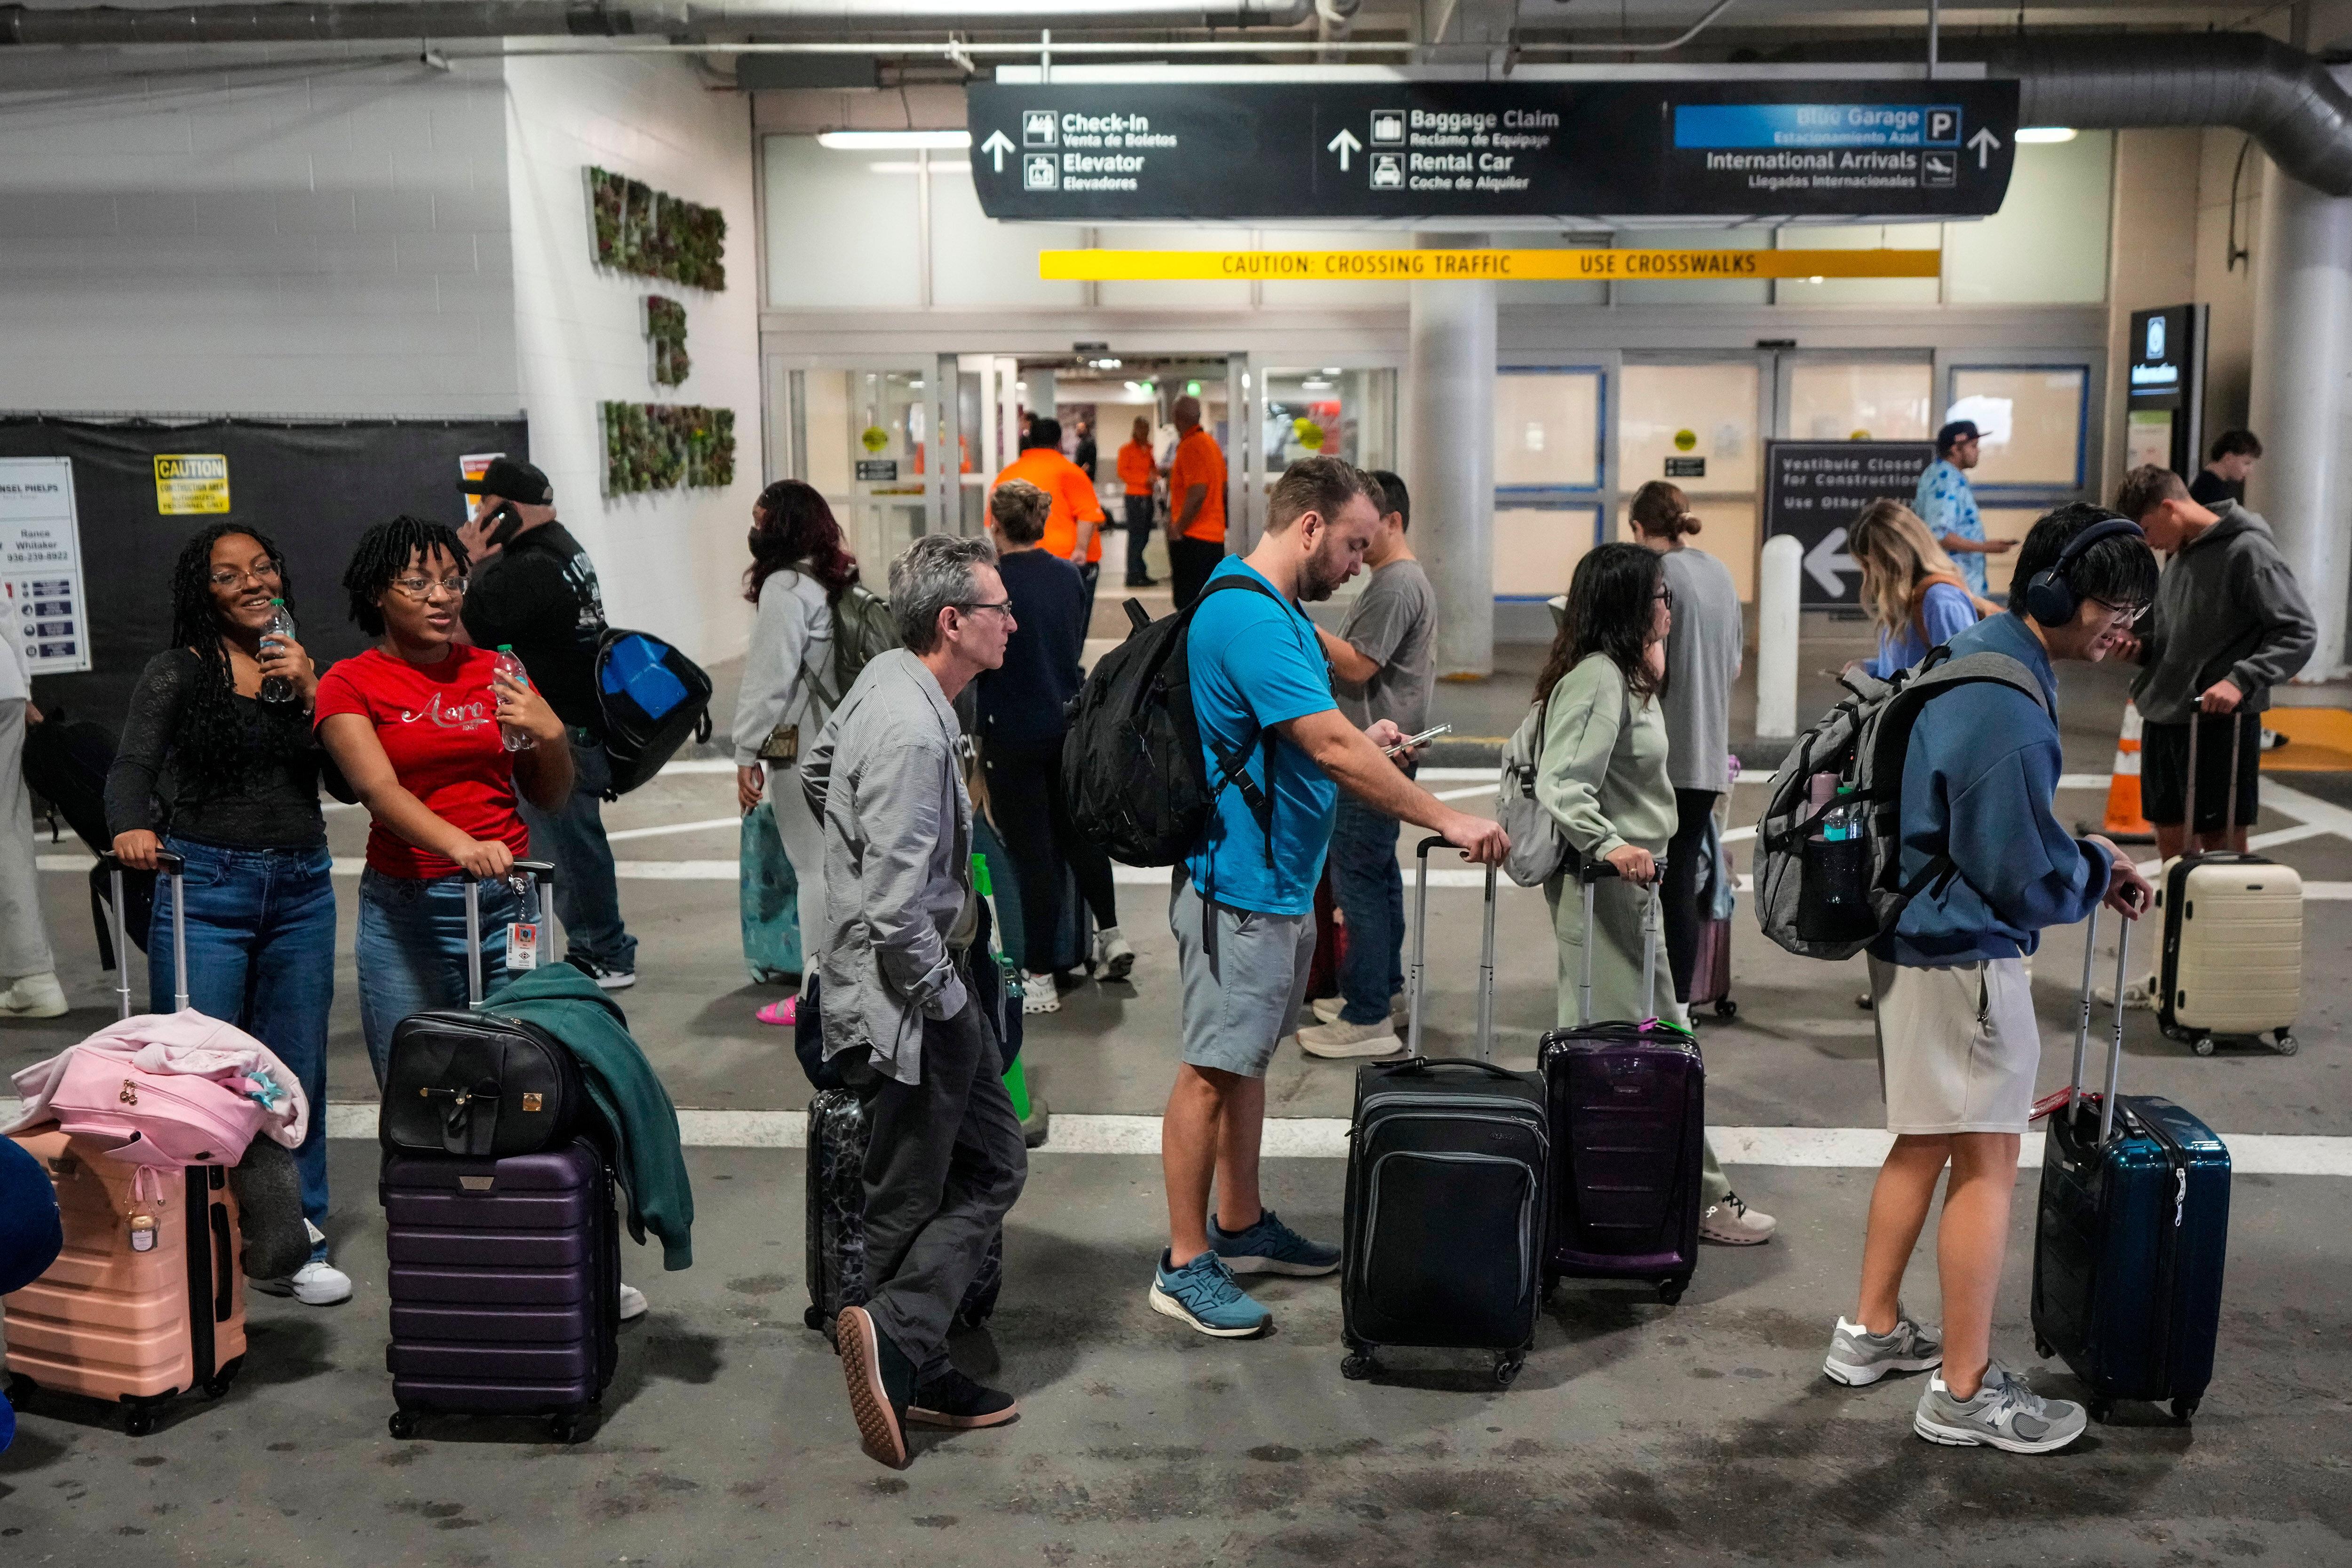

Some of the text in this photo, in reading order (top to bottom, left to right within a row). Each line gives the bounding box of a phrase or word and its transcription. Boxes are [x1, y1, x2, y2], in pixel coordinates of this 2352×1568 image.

[1062, 113, 1149, 133] Check-In
[1411, 110, 1559, 133] Baggage Claim
[1848, 107, 1920, 129] Garage
[1932, 113, 1952, 138] P
[1063, 133, 1177, 148] Venta de Boletos
[1410, 133, 1469, 147] Reclamo
[1471, 133, 1489, 147] de
[1063, 152, 1145, 172] Elevator
[1410, 152, 1515, 172] Rental Car
[1707, 151, 1916, 169] International Arrivals
[1063, 176, 1138, 191] Elevadores
[1409, 175, 1530, 193] Coche de Alquiler
[1748, 175, 1809, 191] Llegadas
[1223, 254, 1756, 273] CAUTION: CROSSING TRAFFIC USE CROSSWALKS
[159, 460, 222, 478] CAUTION
[1783, 458, 1923, 470] Vestibule Closed
